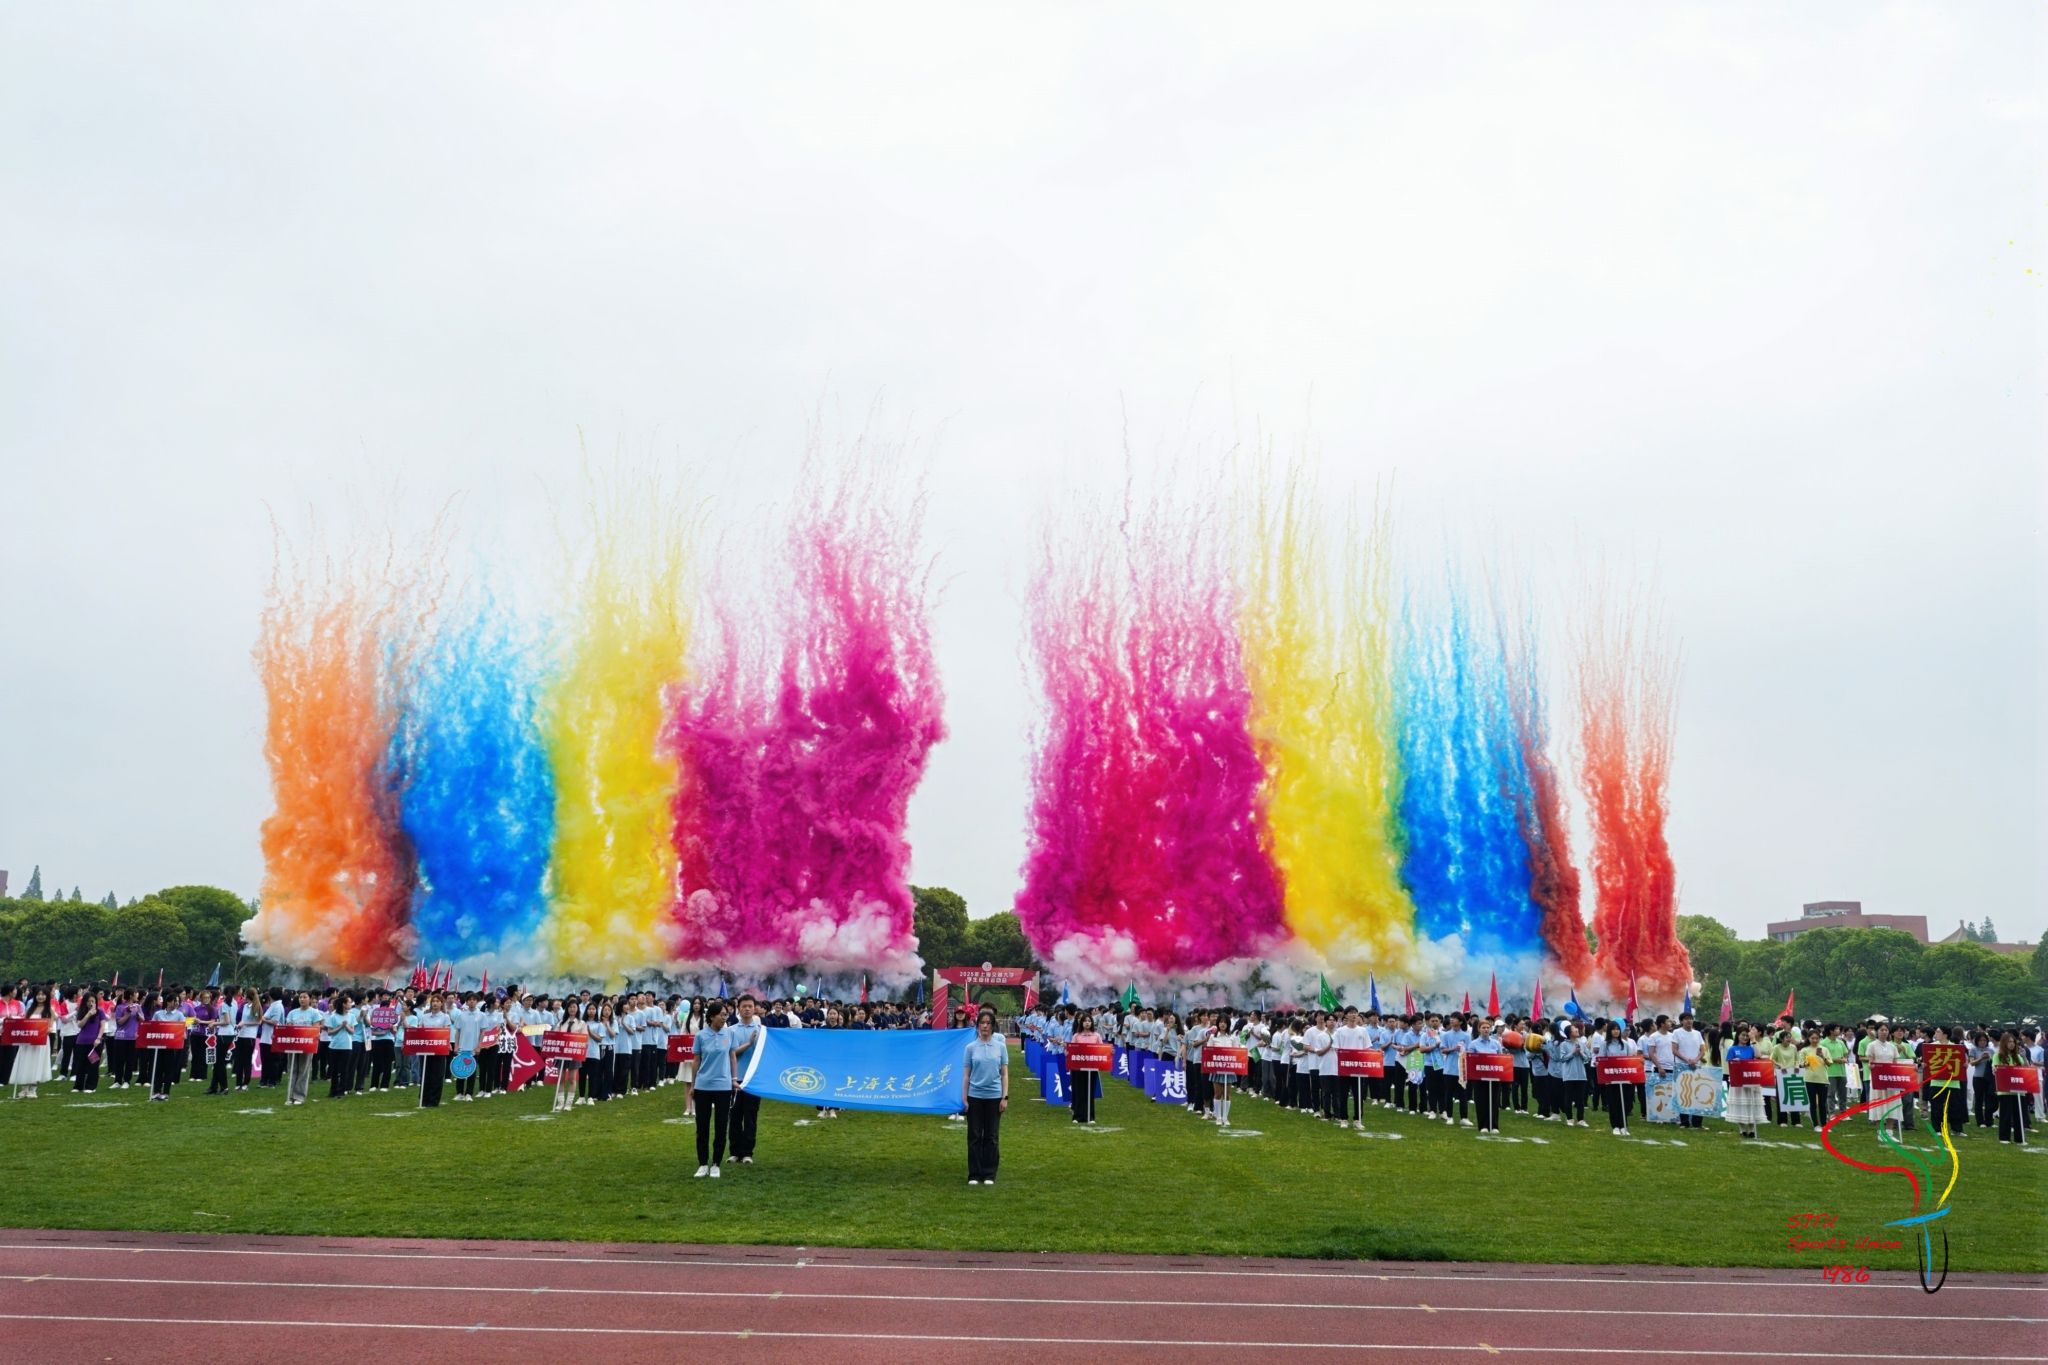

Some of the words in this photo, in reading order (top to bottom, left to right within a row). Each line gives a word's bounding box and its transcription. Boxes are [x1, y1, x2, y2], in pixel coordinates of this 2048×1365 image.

[835, 1063, 952, 1092] 上海交通大学
[1928, 1047, 1961, 1078] 药
[1160, 1068, 1188, 1099] 想
[1782, 1074, 1809, 1106] 肩
